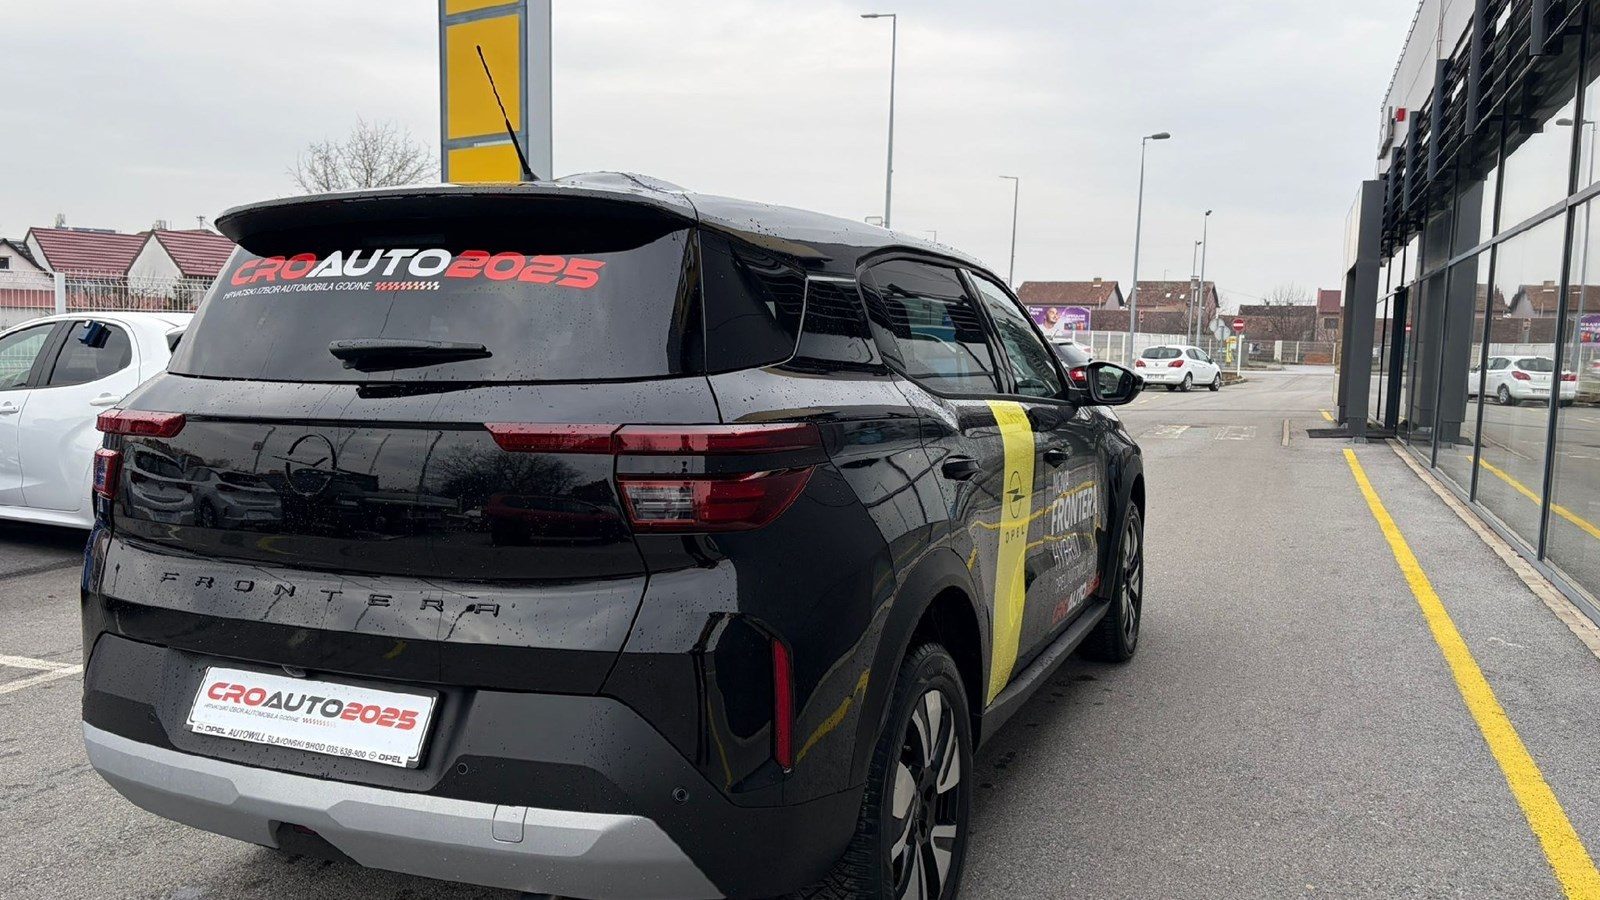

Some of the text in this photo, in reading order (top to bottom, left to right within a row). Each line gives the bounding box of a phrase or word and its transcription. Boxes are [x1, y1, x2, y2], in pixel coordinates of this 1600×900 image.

[230, 248, 606, 289] CROAUTO2025
[222, 281, 373, 300] HRVATSKI IZBOR AUTOMOBILA GODINE
[1050, 484, 1098, 536] FRONTERA
[1005, 524, 1025, 544] OPEL
[160, 571, 501, 617] FRONTERA
[207, 681, 419, 731] CROAUTO2025
[204, 725, 226, 735] OPEL
[227, 728, 265, 742] AUTOWILL
[266, 735, 305, 748] SLAVONSKI
[378, 753, 403, 764] OPEL
